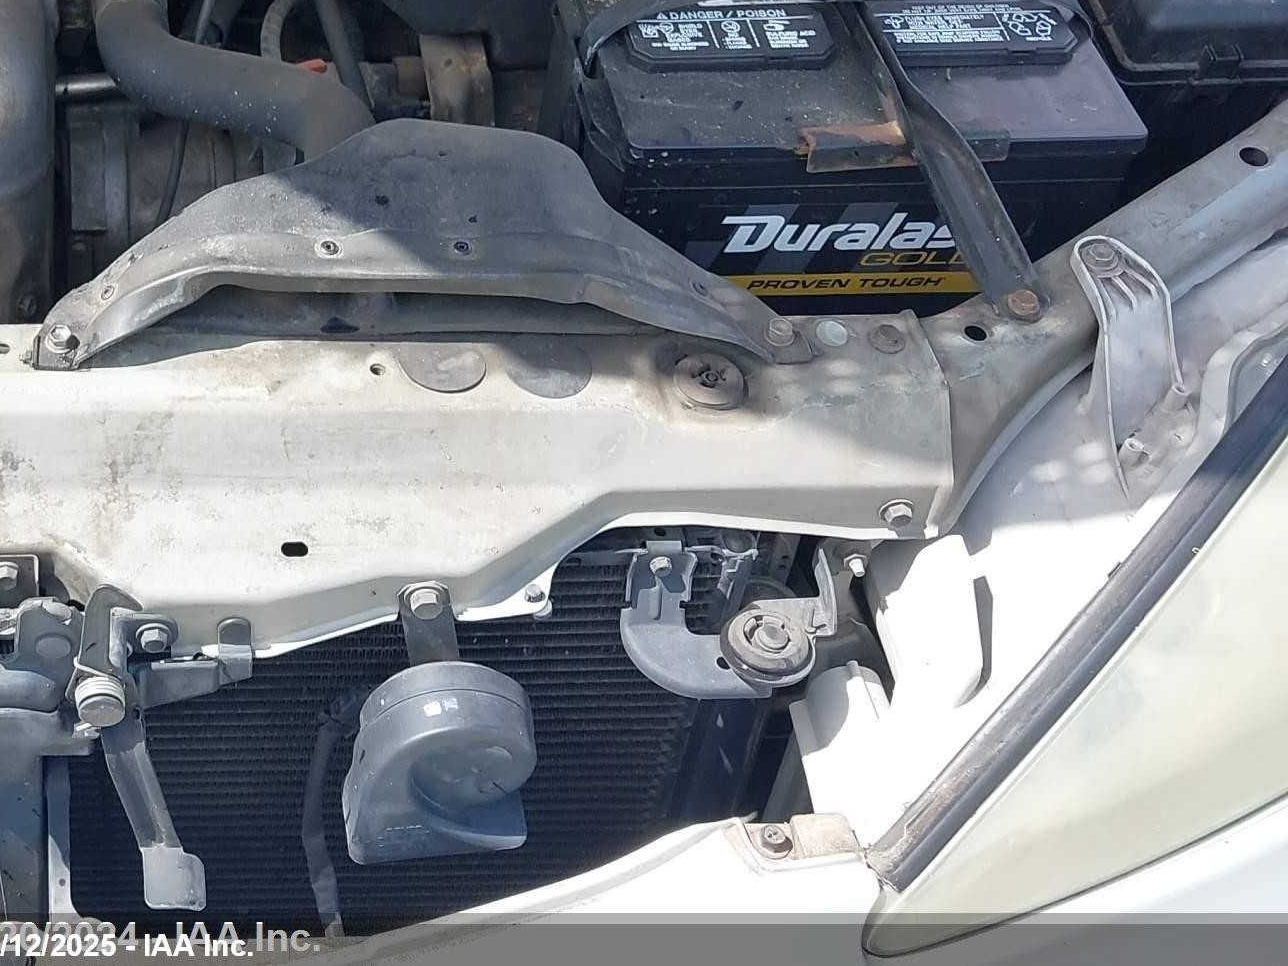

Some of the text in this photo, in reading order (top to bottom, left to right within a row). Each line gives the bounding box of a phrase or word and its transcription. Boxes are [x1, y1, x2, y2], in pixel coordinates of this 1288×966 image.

[669, 10, 724, 20] DANGER
[736, 9, 787, 18] POISON
[721, 212, 957, 253] Duralas
[746, 276, 944, 291] PROVEN TOUGH
